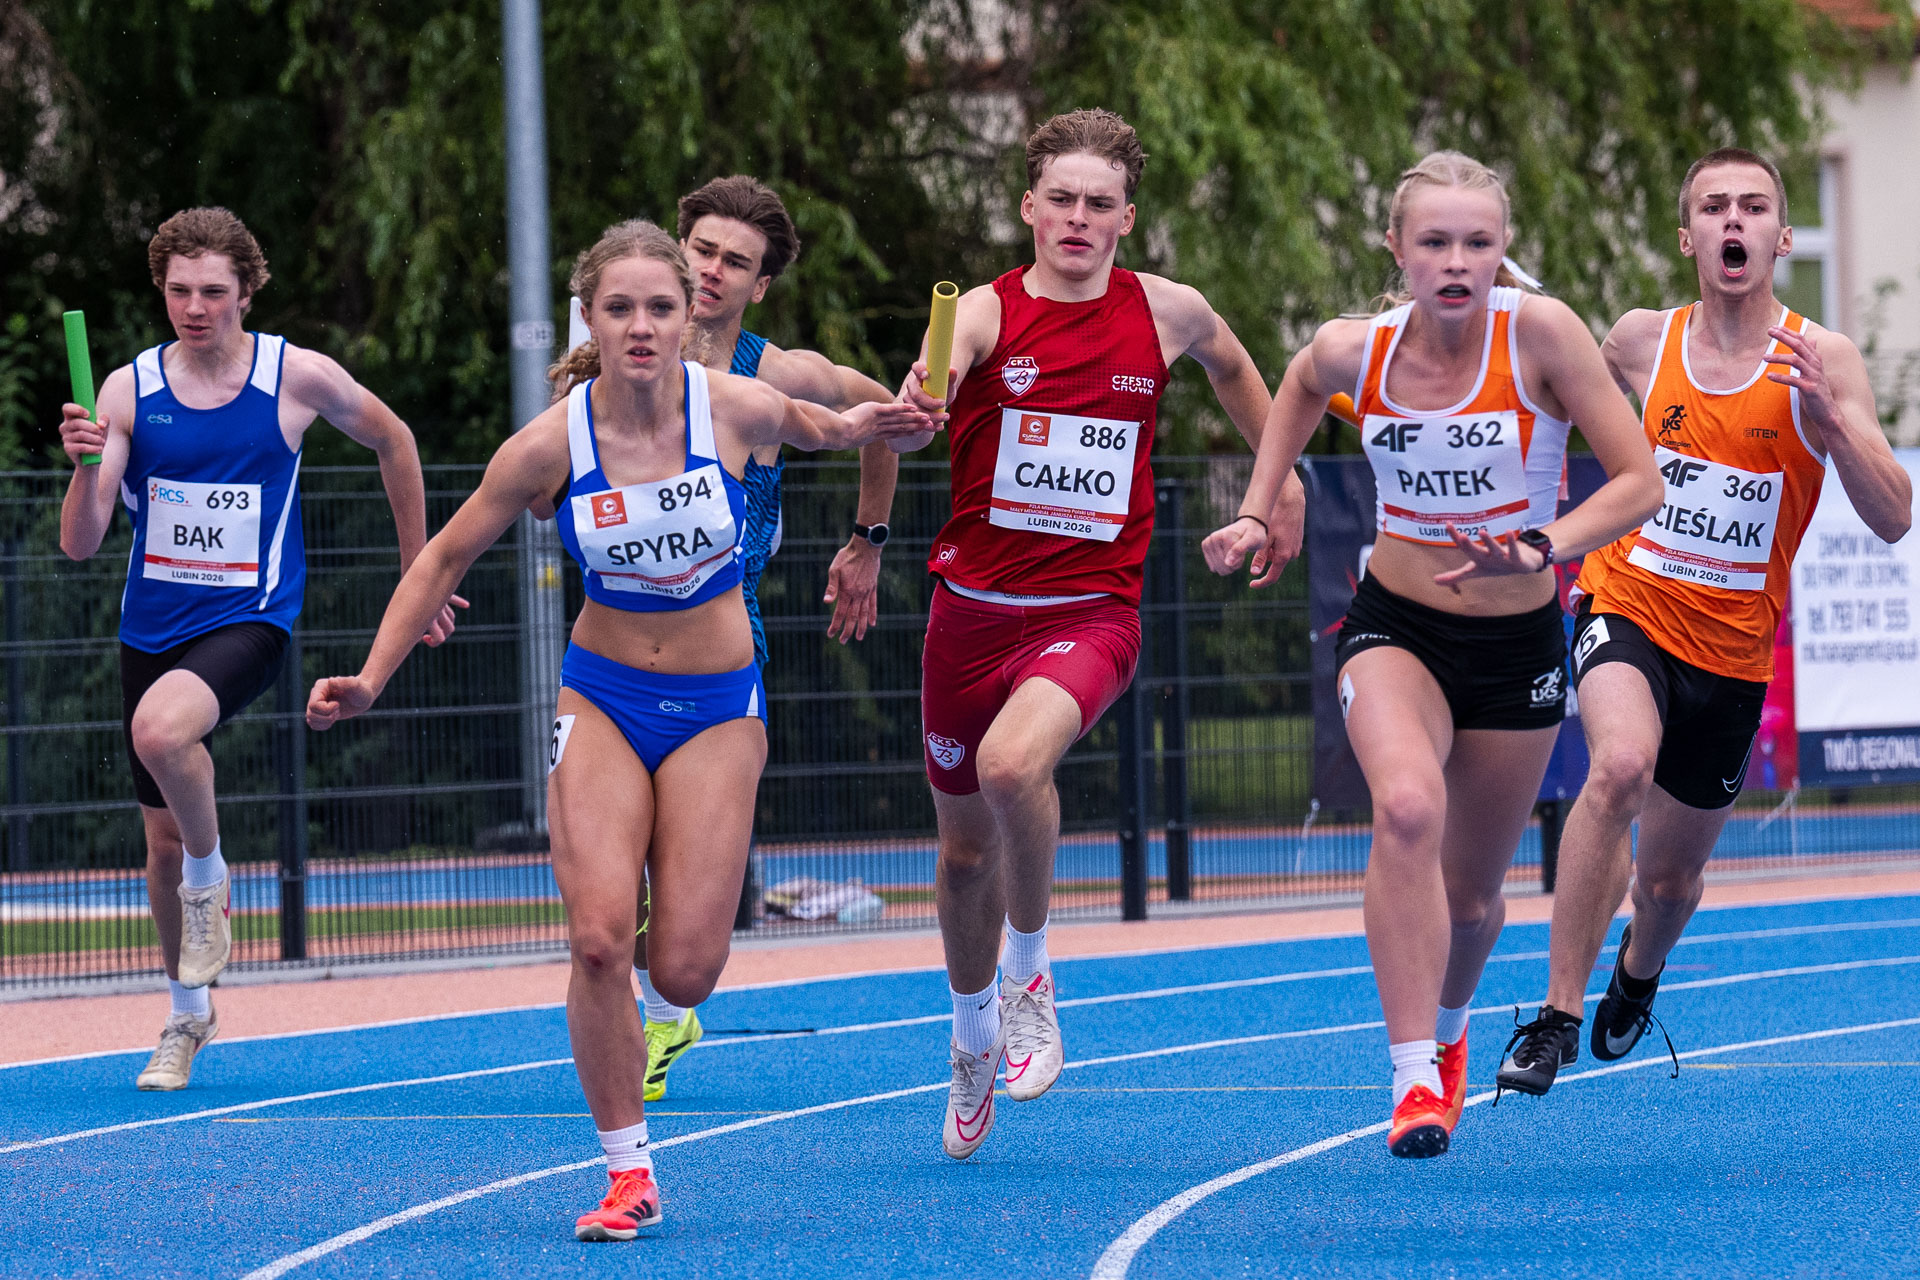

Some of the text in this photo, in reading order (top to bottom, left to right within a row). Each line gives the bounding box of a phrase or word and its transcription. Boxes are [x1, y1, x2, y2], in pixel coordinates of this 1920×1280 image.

[1011, 359, 1030, 367] CKS
[147, 414, 173, 424] esa
[1661, 418, 1682, 430] UKS
[1080, 424, 1127, 450] 886
[1371, 421, 1503, 452] 4F 362
[1015, 462, 1115, 497] CAŁKO
[1397, 467, 1495, 497] PATEK
[1660, 458, 1772, 503] 4F 360
[206, 490, 249, 510] 693
[658, 476, 712, 512] 894
[1027, 517, 1092, 533] LUBIN 2026
[173, 524, 224, 552] BĄK
[607, 526, 713, 566] SPYRA
[172, 570, 224, 582] LUBIN 2026
[1662, 562, 1728, 584] LUBIN 2026
[640, 575, 701, 595] LUBIN 2026
[659, 700, 696, 712] esa
[550, 721, 562, 766] 6
[932, 735, 952, 747] CKS
